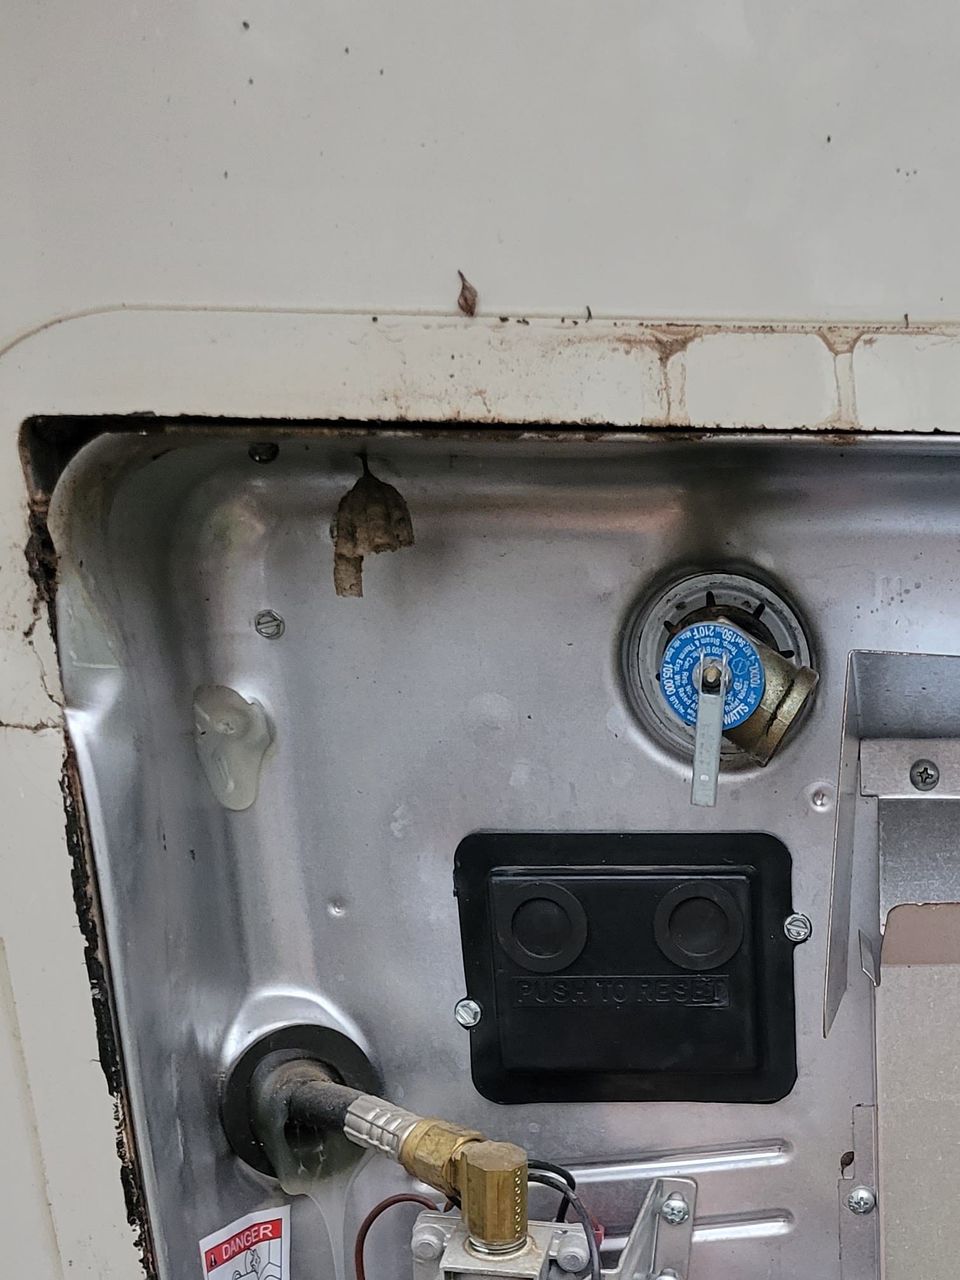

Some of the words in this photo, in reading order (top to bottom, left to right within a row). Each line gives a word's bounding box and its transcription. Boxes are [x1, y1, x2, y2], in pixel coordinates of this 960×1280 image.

[723, 629, 737, 643] 150
[662, 664, 676, 695] 105,000
[723, 703, 748, 725] WATTS
[517, 984, 587, 1004] PUSH
[597, 983, 627, 1003] TO
[637, 980, 725, 1003] RESET
[222, 1224, 273, 1259] DANGER
